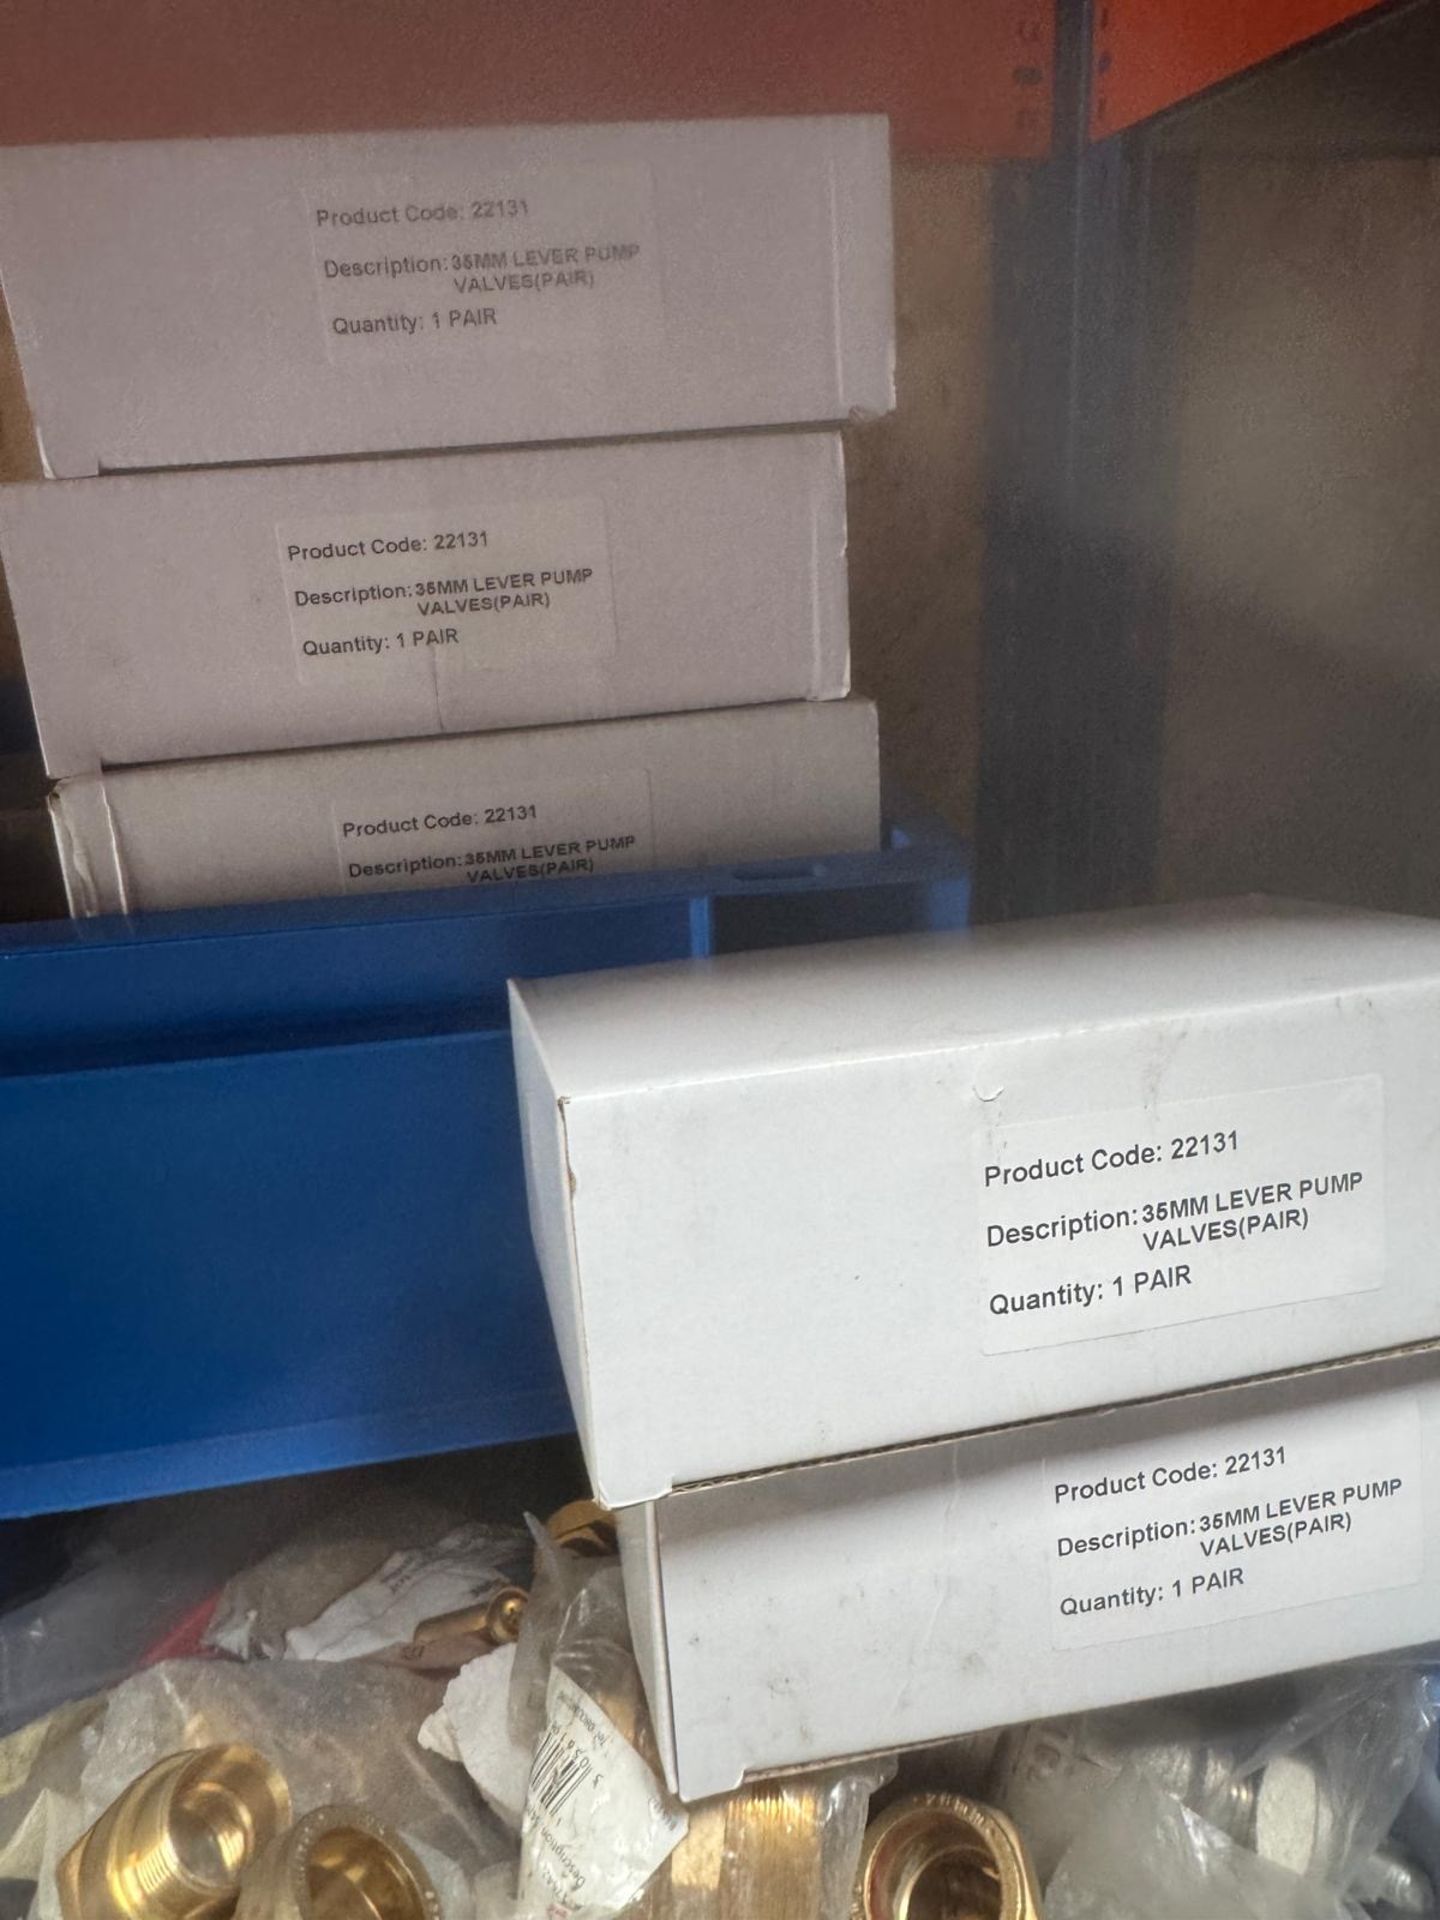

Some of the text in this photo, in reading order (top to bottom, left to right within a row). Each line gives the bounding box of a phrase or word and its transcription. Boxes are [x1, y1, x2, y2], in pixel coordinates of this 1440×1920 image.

[317, 199, 529, 227] Product Code: 22131
[324, 243, 640, 279] Description: 35MM LEVER PUMP
[453, 270, 594, 293] VALVES(PAIR)
[332, 307, 497, 335] Quantity: 1 PAIR
[288, 530, 489, 561] Product Code: 22131
[295, 568, 593, 607] Description: 35MM LEVER PUMP
[417, 594, 551, 617] VALVES(PAIR)
[303, 628, 459, 657] Quantity: 1 PAIR
[343, 805, 537, 837] Product Code: 22131
[349, 835, 635, 878] Description: 35MM LEVER PUMP
[467, 860, 594, 884] VALVES(PAIR)
[984, 1130, 1238, 1187] Product Code: 22131
[987, 1171, 1363, 1247] Description: 35MM LEVER PUMP
[1143, 1208, 1309, 1251] VALVES(PAIR)
[990, 1265, 1192, 1315] Quantity: 1 PAIR
[1055, 1446, 1286, 1504] Product Code: 22131
[1058, 1478, 1402, 1557] Description: 35MM LEVER PUMP
[1200, 1512, 1352, 1557] VALVES(PAIR)
[1060, 1567, 1244, 1616] Quantity: 1 PAIR
